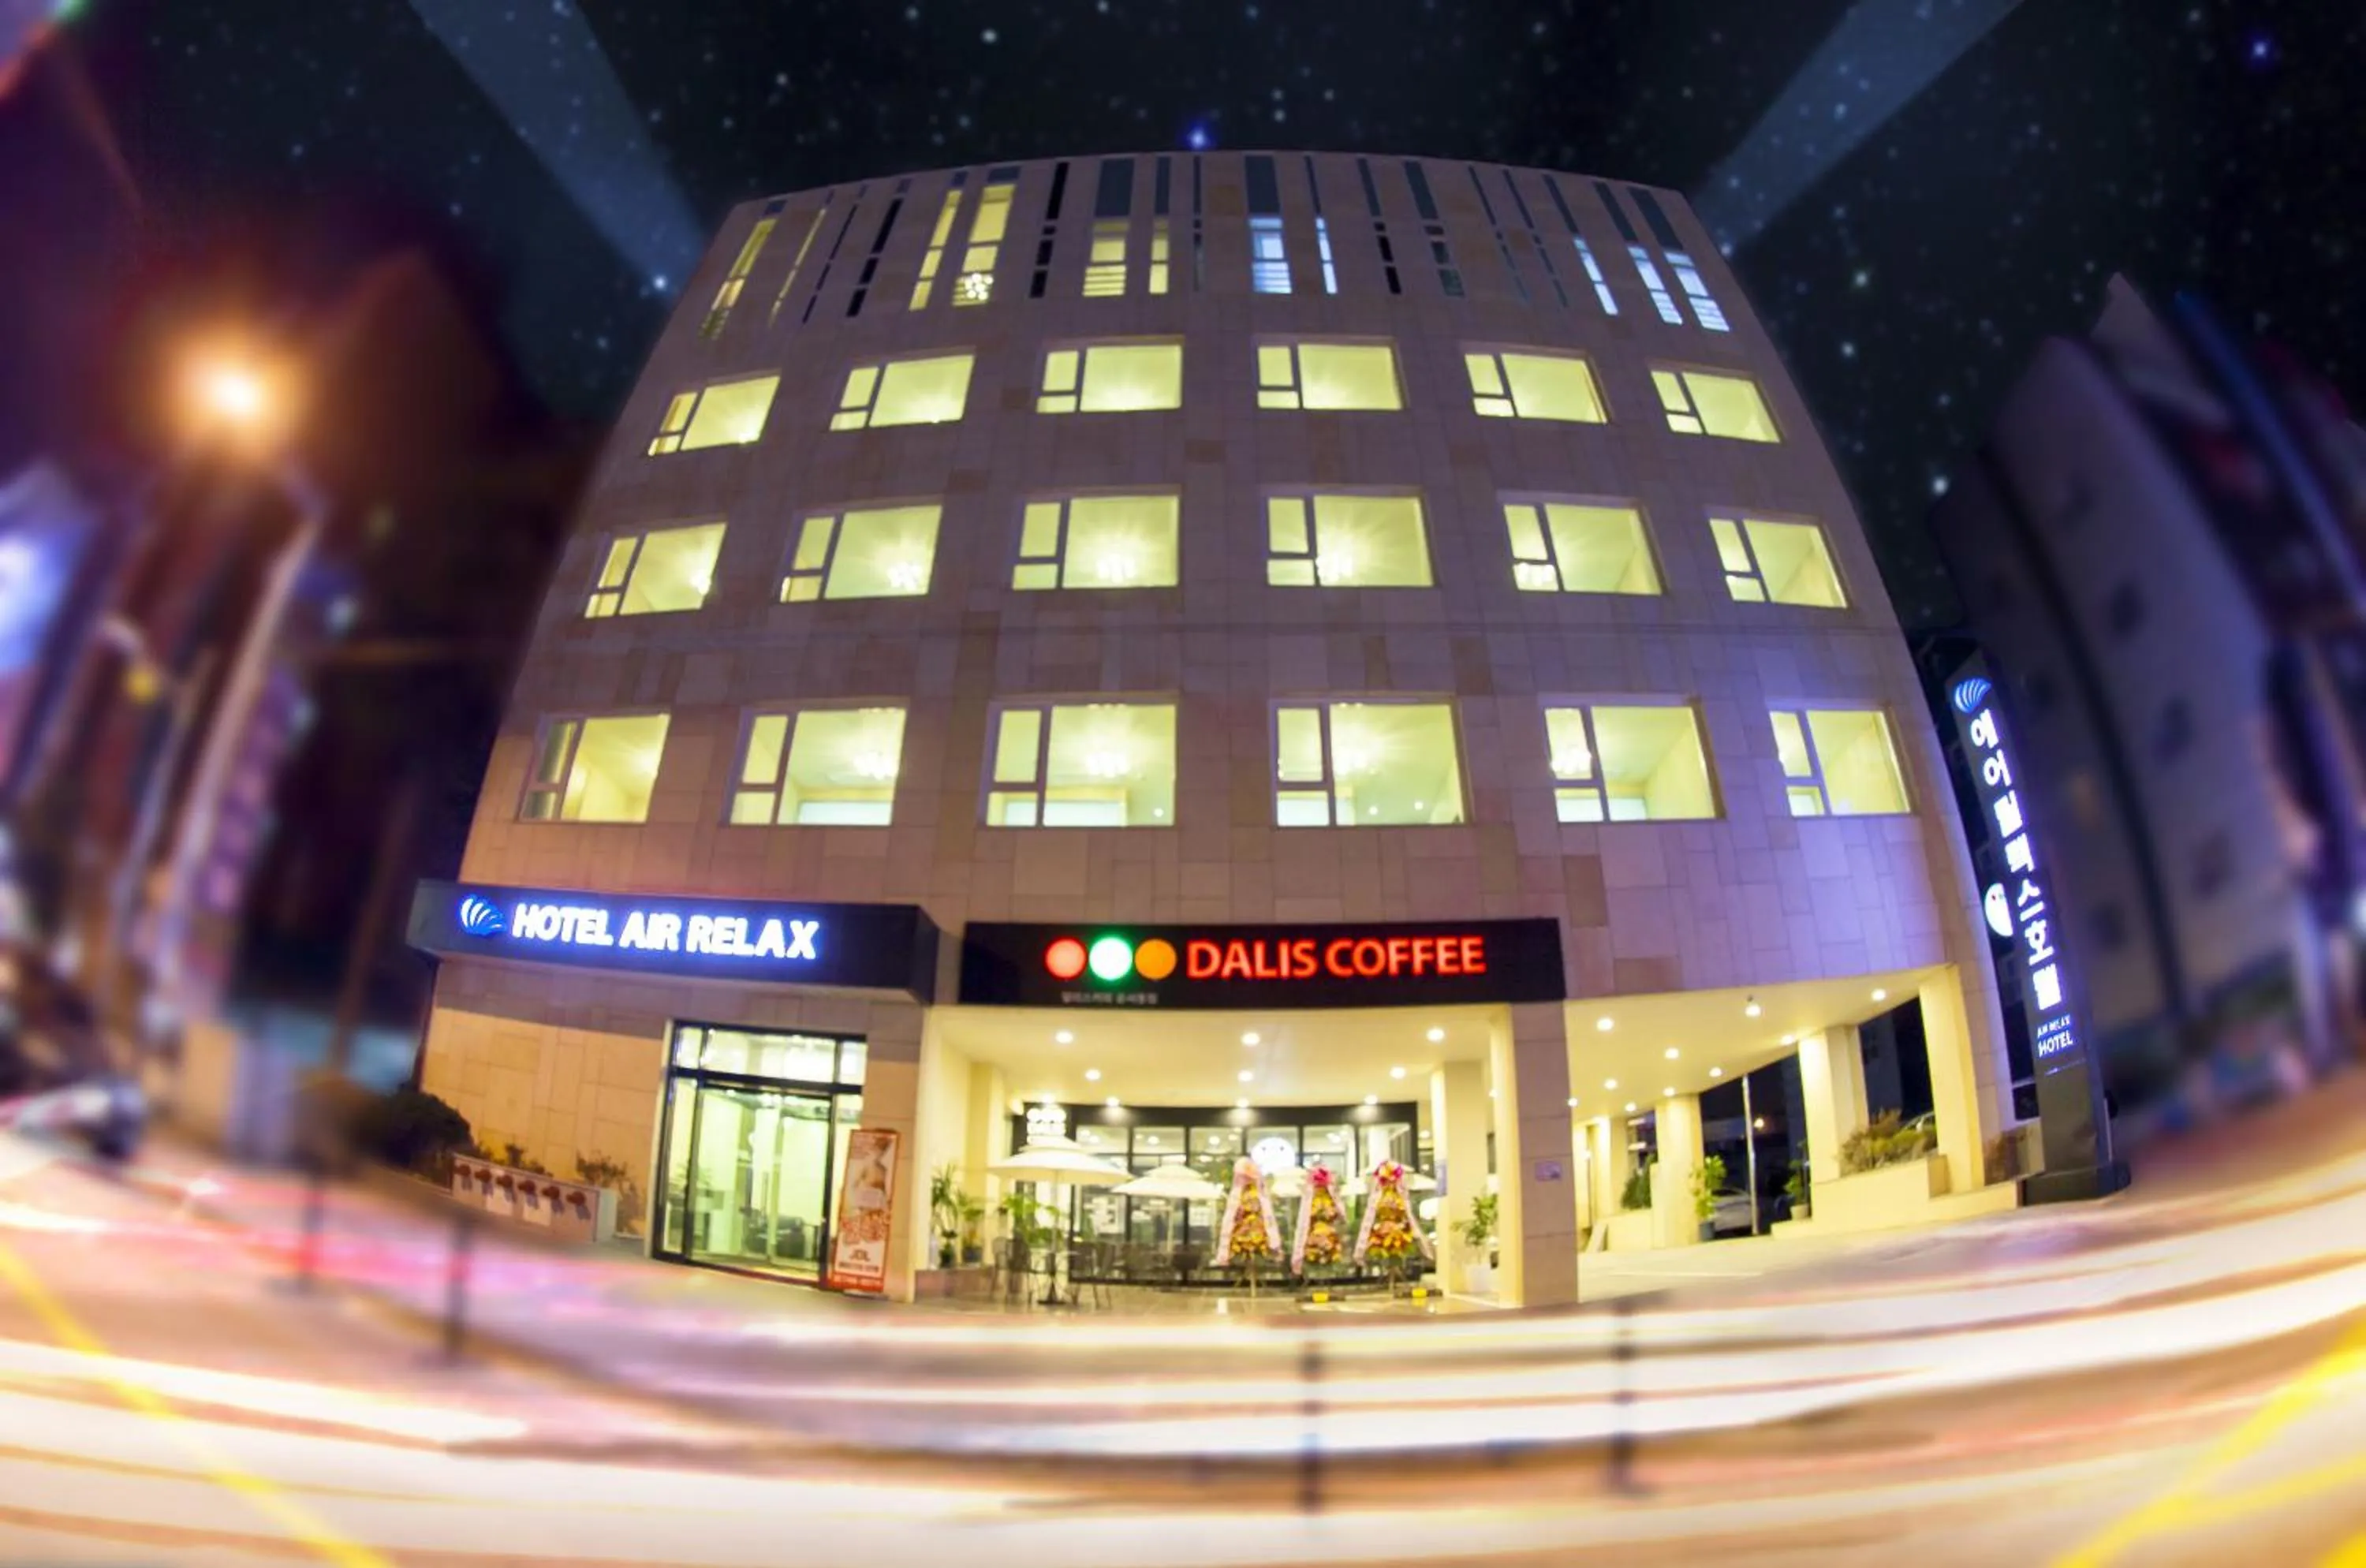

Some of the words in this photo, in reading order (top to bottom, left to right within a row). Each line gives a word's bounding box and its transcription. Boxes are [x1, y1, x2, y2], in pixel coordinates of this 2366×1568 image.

[511, 902, 614, 946] HOTEL
[618, 910, 682, 951] AIR
[685, 913, 819, 960] RELAX
[1185, 939, 1319, 979] DALIS
[1324, 935, 1486, 977] COFFEE
[2038, 1029, 2073, 1058] HOTEL
